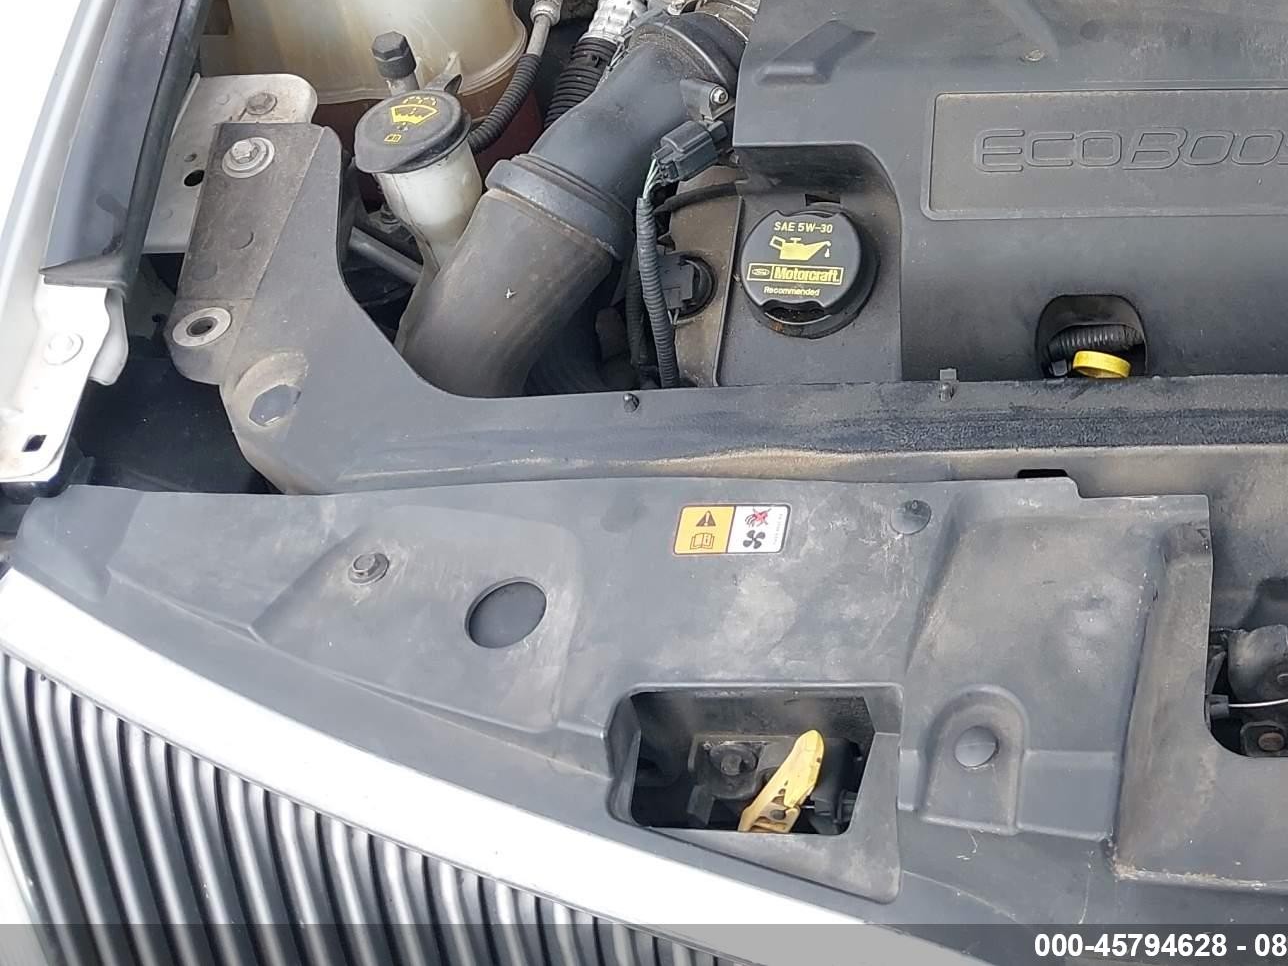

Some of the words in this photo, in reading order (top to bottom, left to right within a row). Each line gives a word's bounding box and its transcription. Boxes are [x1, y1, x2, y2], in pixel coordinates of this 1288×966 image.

[774, 221, 795, 232] SAE
[797, 221, 833, 234] 5W-30
[763, 286, 820, 296] Recommended
